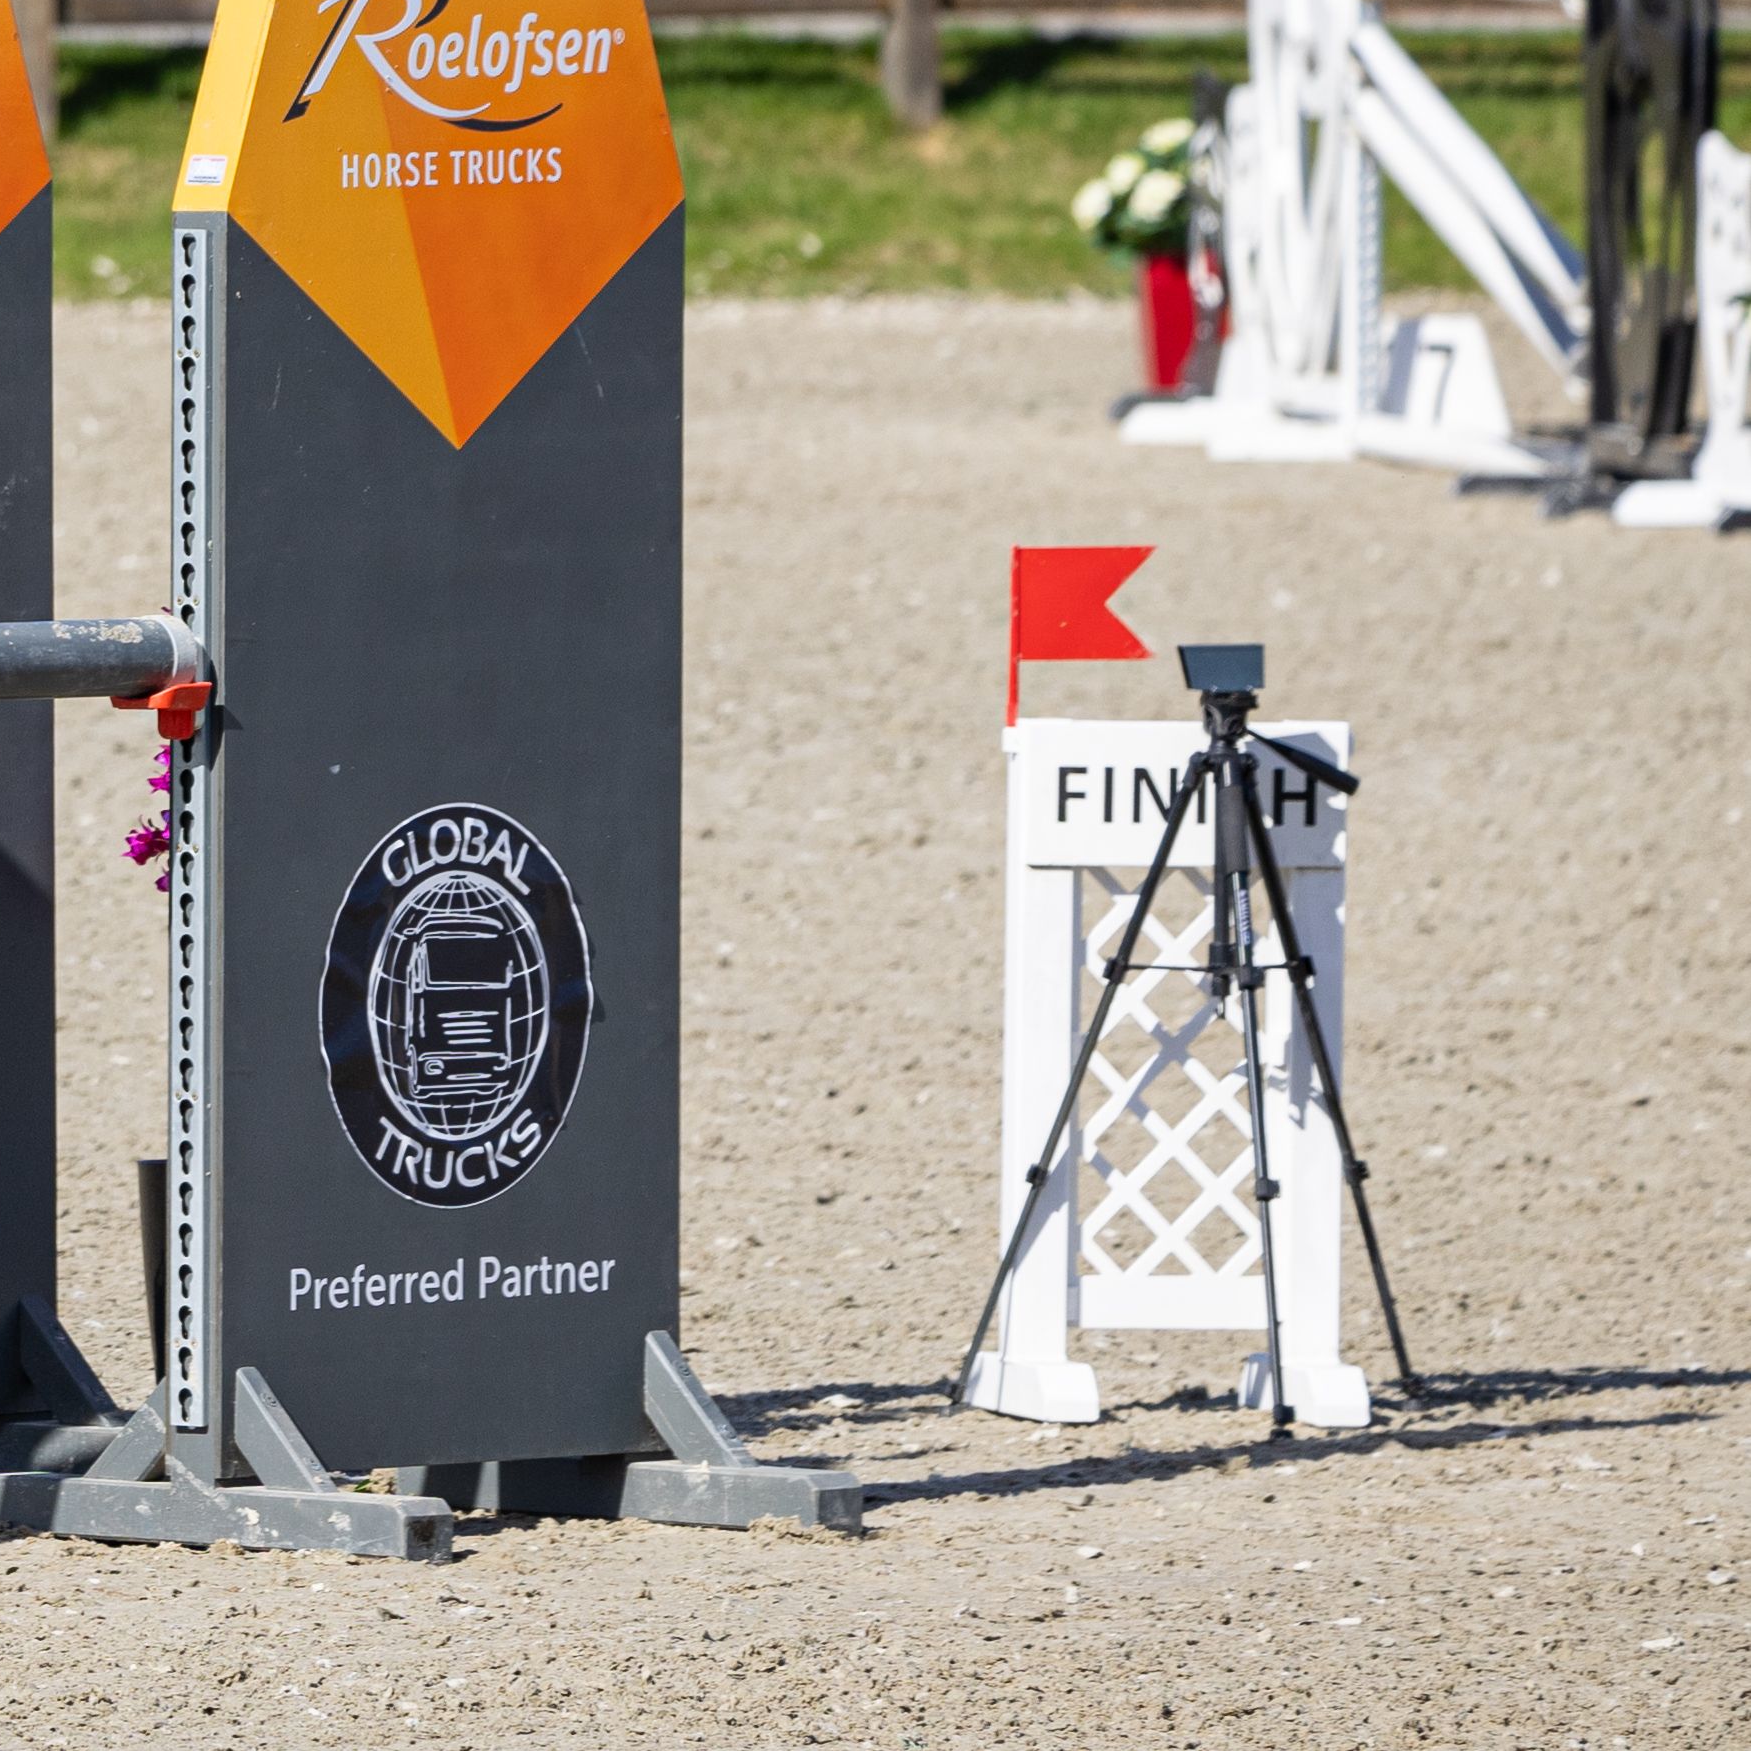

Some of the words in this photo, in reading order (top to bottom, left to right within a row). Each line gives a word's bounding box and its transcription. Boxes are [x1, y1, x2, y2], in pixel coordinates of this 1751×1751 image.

[342, 151, 438, 188] HORSE
[449, 147, 562, 185] TRUCKS
[1057, 766, 1317, 827] FINIH
[382, 817, 531, 895] GLOBAL
[375, 1108, 542, 1189] TRUCKS
[290, 1258, 464, 1311] Preferred
[479, 1256, 615, 1299] Partner
